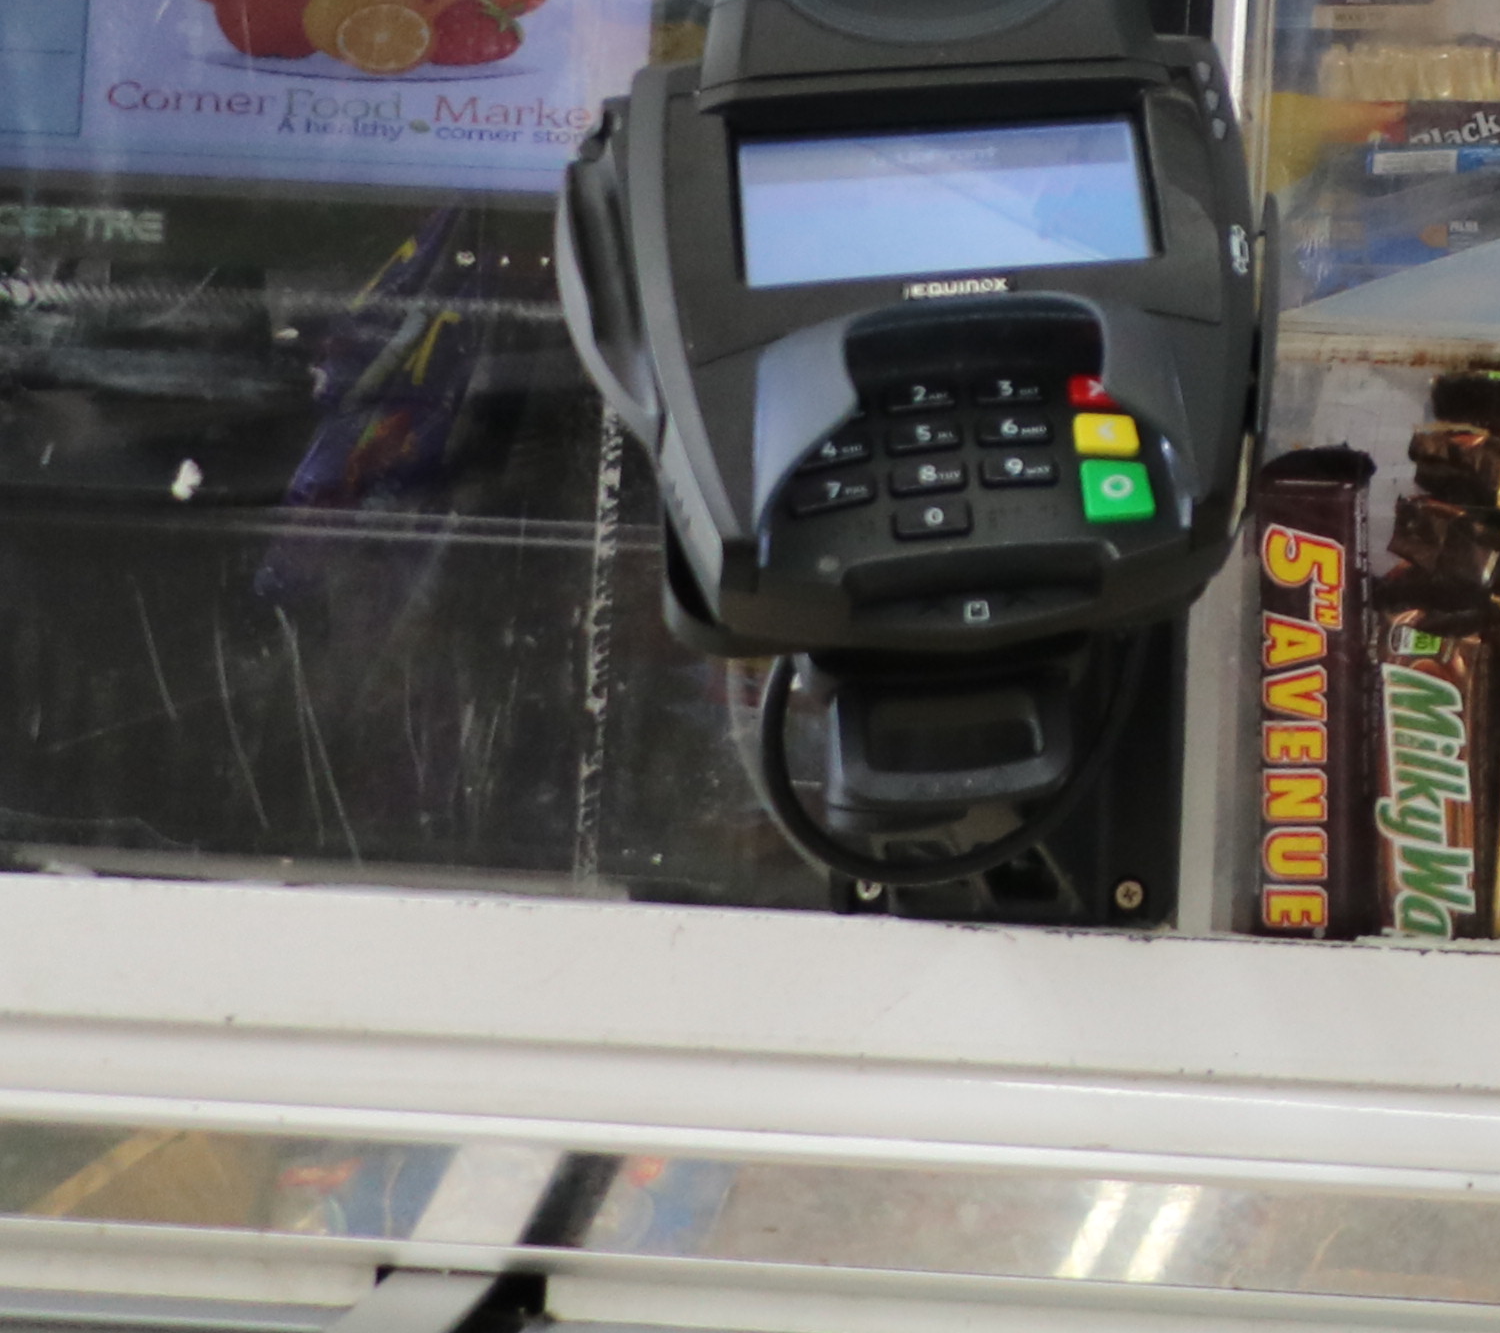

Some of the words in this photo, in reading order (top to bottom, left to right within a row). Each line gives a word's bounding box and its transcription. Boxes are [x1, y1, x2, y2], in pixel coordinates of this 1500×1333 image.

[107, 79, 267, 117] Corner
[283, 88, 402, 121] Food
[1263, 614, 1327, 929] AVENUE
